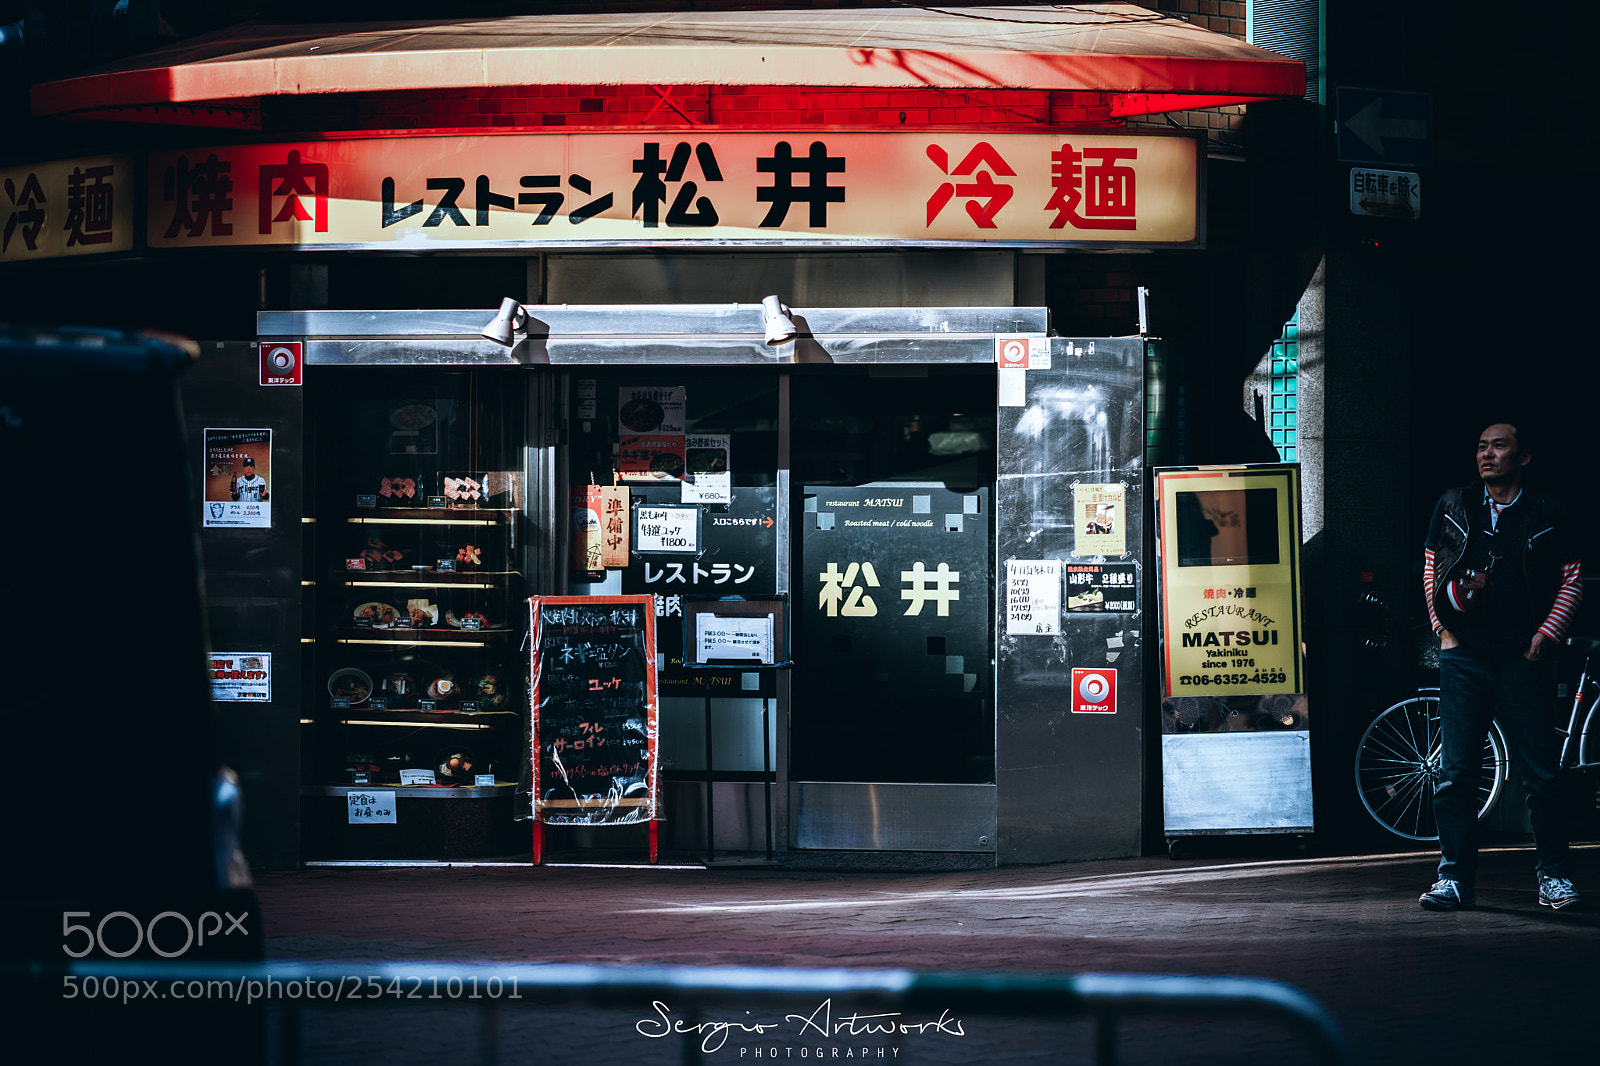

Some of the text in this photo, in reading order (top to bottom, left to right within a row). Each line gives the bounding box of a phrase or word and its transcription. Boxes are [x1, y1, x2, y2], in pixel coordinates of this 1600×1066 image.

[164, 141, 1138, 238] 焼肉 レストラン 松井 冷麺
[1354, 171, 1418, 198] 自転車を除く
[2, 165, 114, 253] 冷麺
[863, 498, 904, 507] MATSUI
[606, 498, 624, 550] 準備中
[844, 519, 872, 527] Roasted
[896, 519, 911, 527] cold
[911, 519, 934, 527] noodle
[660, 537, 687, 547] ¥1800
[644, 562, 755, 584] レストラン
[1069, 572, 1094, 585] 山形牛
[818, 561, 960, 617] 松井
[1184, 604, 1275, 629] RESTAURANT
[1182, 630, 1278, 647] MATSUI
[1205, 648, 1248, 658] Yakiniku
[1202, 659, 1255, 669] since 1976
[588, 676, 622, 691] ユッケ
[692, 676, 733, 685] MTSUI
[1192, 673, 1287, 686] 06-6352-4529
[349, 793, 377, 806] 定食は
[354, 807, 391, 818] お昼のみ
